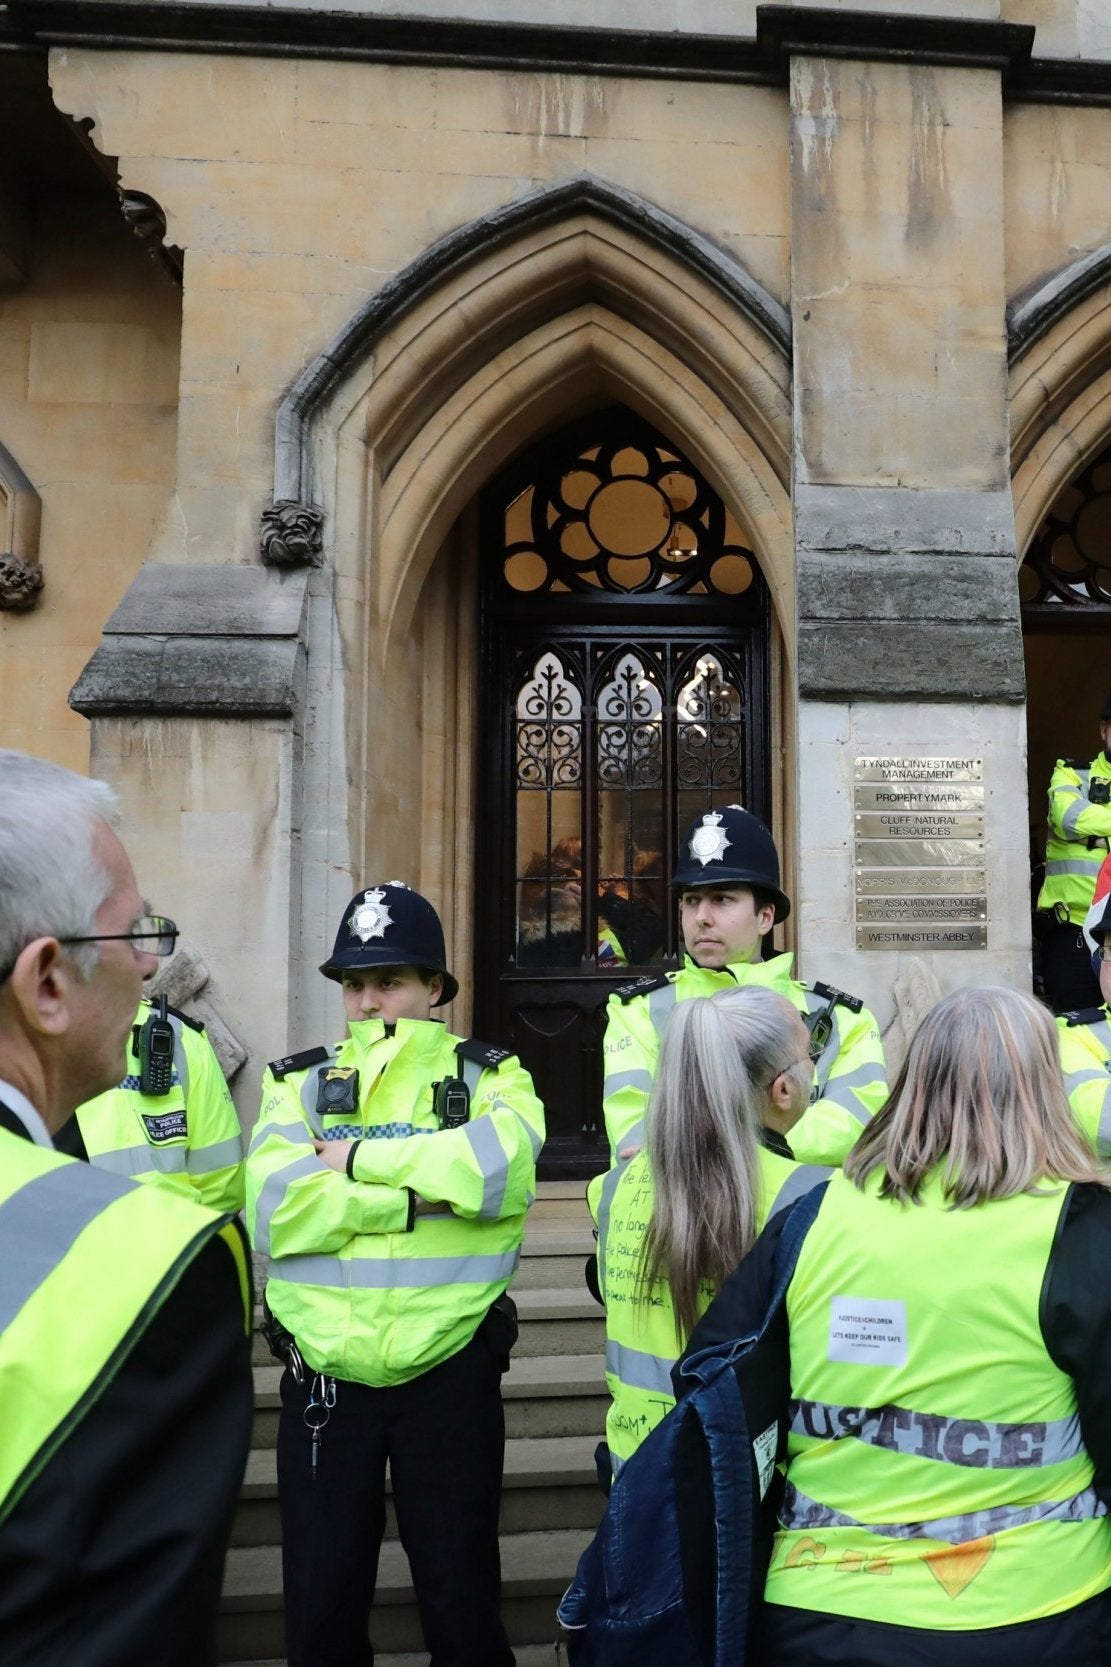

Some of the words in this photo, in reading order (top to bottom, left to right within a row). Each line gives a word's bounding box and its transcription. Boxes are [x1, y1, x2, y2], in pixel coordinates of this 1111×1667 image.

[862, 760, 908, 768] TYNDALL
[909, 760, 975, 768] INVESTMENT
[882, 770, 954, 778] MANAGEMENT
[876, 793, 962, 802] PROPERTYMARK
[880, 816, 911, 824] CLUFF
[915, 816, 959, 824] NATURAL
[889, 827, 951, 836] RESOURCES
[884, 899, 934, 907] ASSOCIATION
[936, 899, 947, 907] OF
[950, 899, 978, 907] POLICE
[868, 933, 940, 942] WESTMINSTER
[942, 933, 975, 942] ABBEY
[604, 1035, 633, 1055] OLICE
[160, 1119, 182, 1128] POLICE
